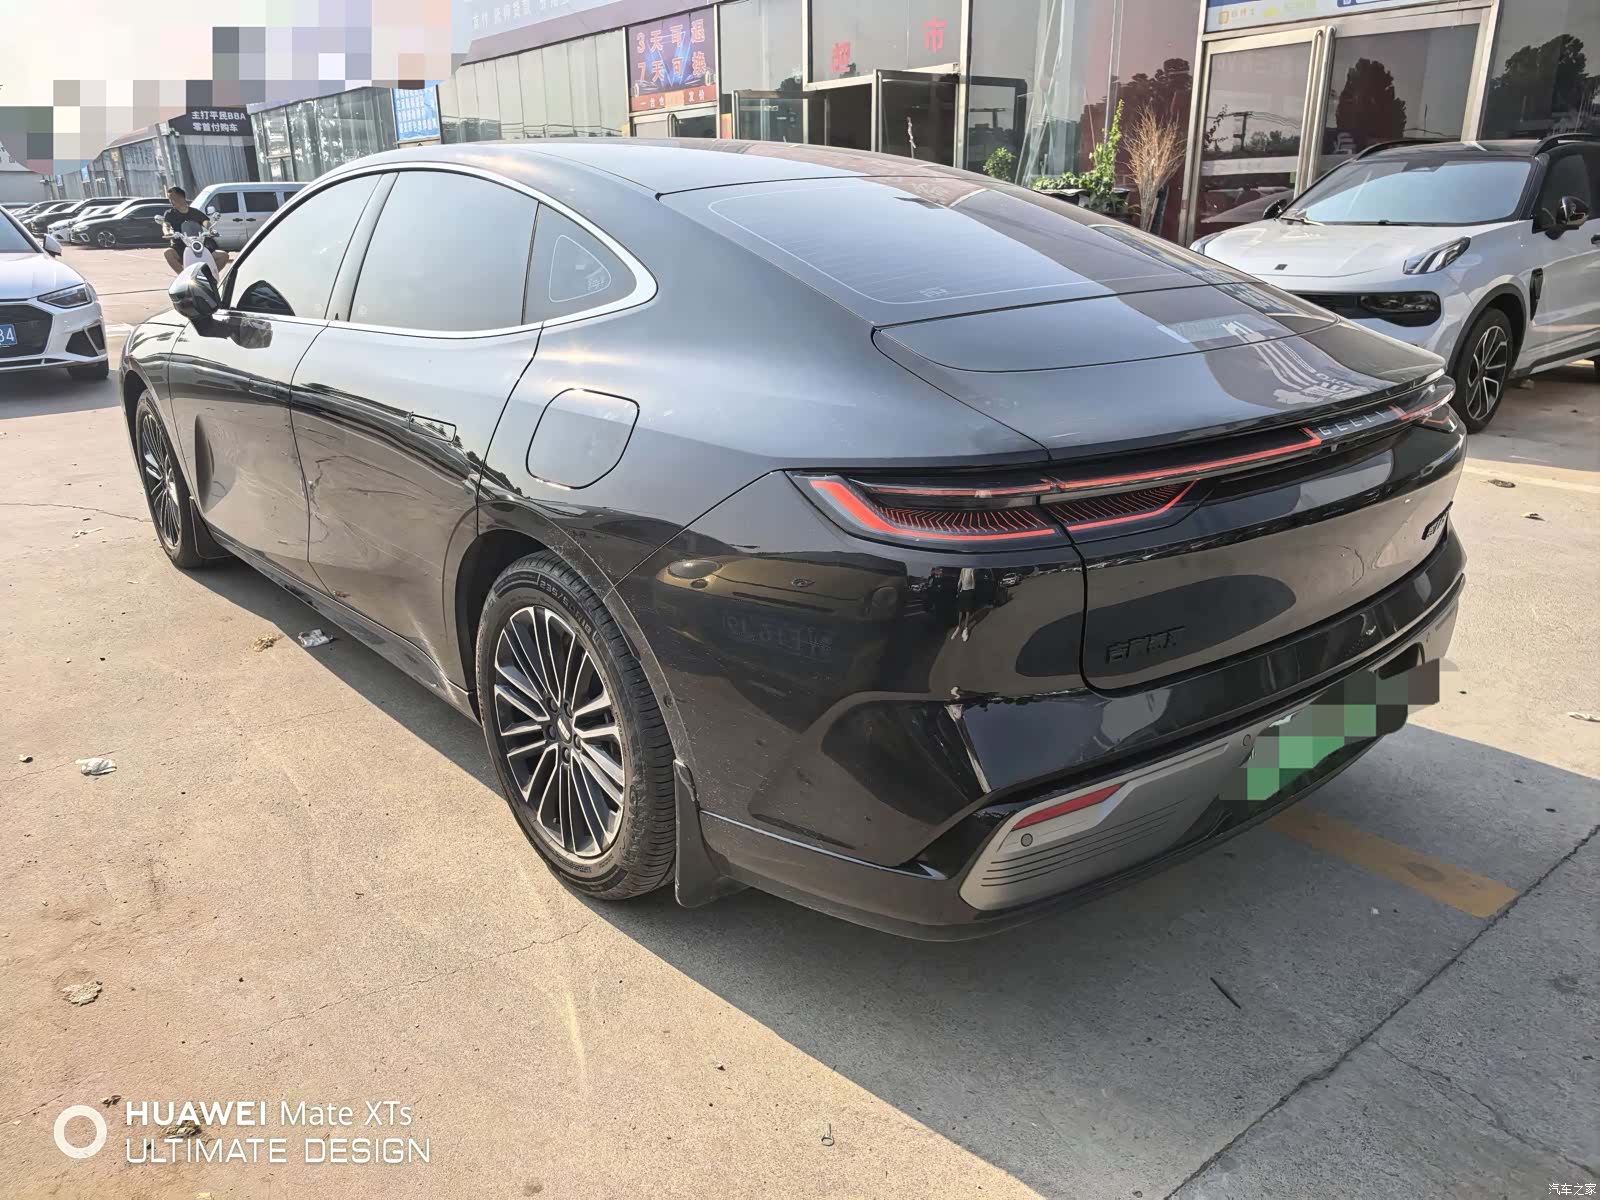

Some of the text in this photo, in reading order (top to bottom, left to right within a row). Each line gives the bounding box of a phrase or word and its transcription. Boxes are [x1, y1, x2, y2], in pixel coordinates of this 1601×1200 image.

[191, 110, 246, 121] 主打平民BBA
[192, 121, 238, 132] 零首付购车
